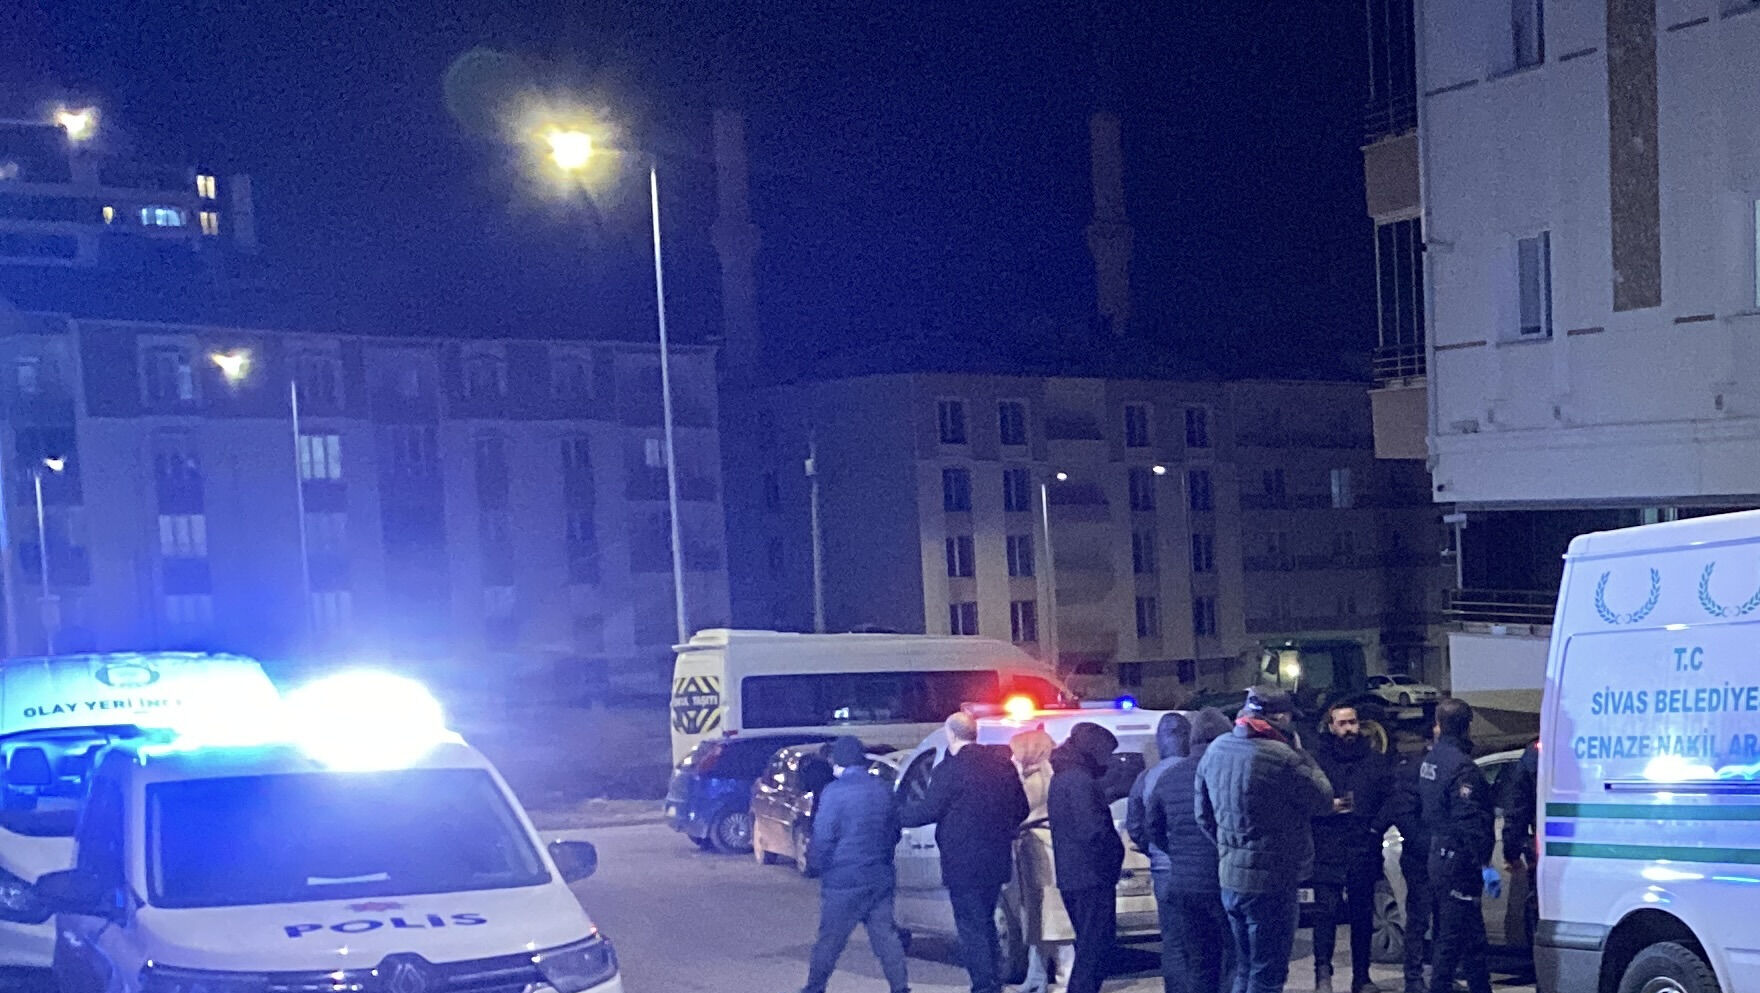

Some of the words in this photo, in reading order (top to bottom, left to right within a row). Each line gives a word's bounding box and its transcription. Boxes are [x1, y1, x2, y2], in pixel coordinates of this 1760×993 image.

[1674, 647, 1704, 672] T.C
[23, 702, 78, 718] OLAY
[1591, 686, 1648, 715] SİVAS
[1574, 735, 1650, 760] CENAZE
[1656, 728, 1717, 758] NAKİL
